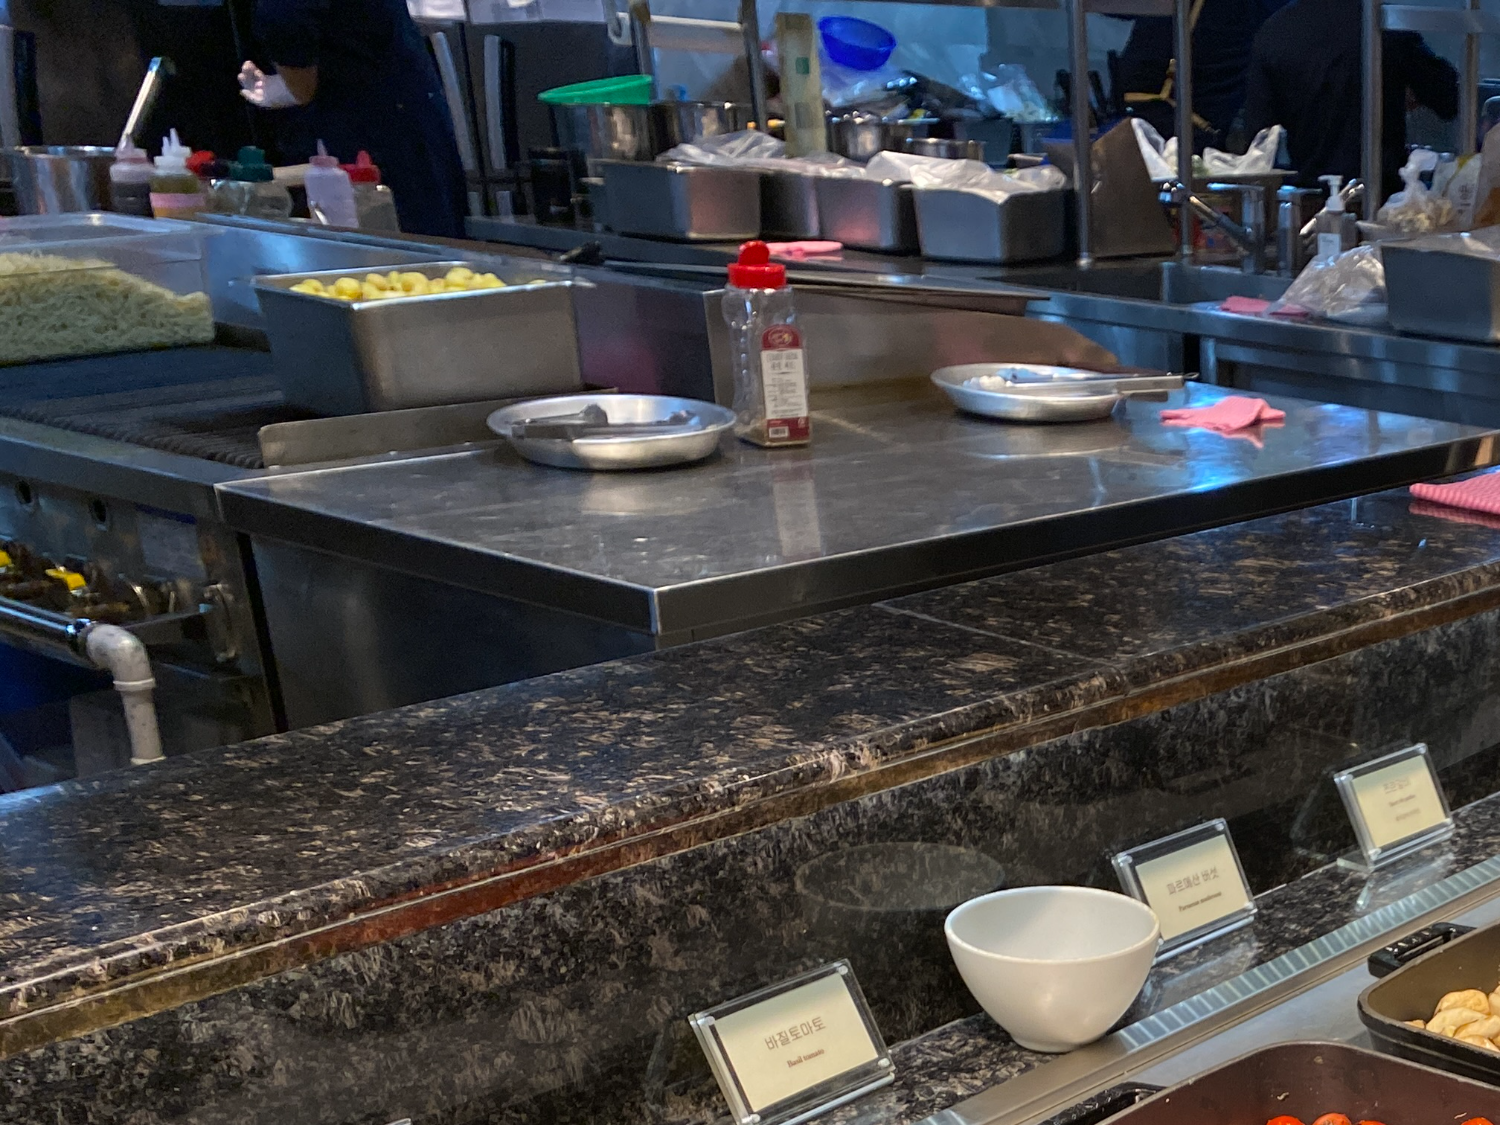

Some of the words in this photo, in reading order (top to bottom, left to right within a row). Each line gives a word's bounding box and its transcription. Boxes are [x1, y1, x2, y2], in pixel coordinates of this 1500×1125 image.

[764, 1016, 827, 1051] 바질토마토
[786, 1055, 803, 1068] Basil
[803, 1048, 825, 1061] tomato
